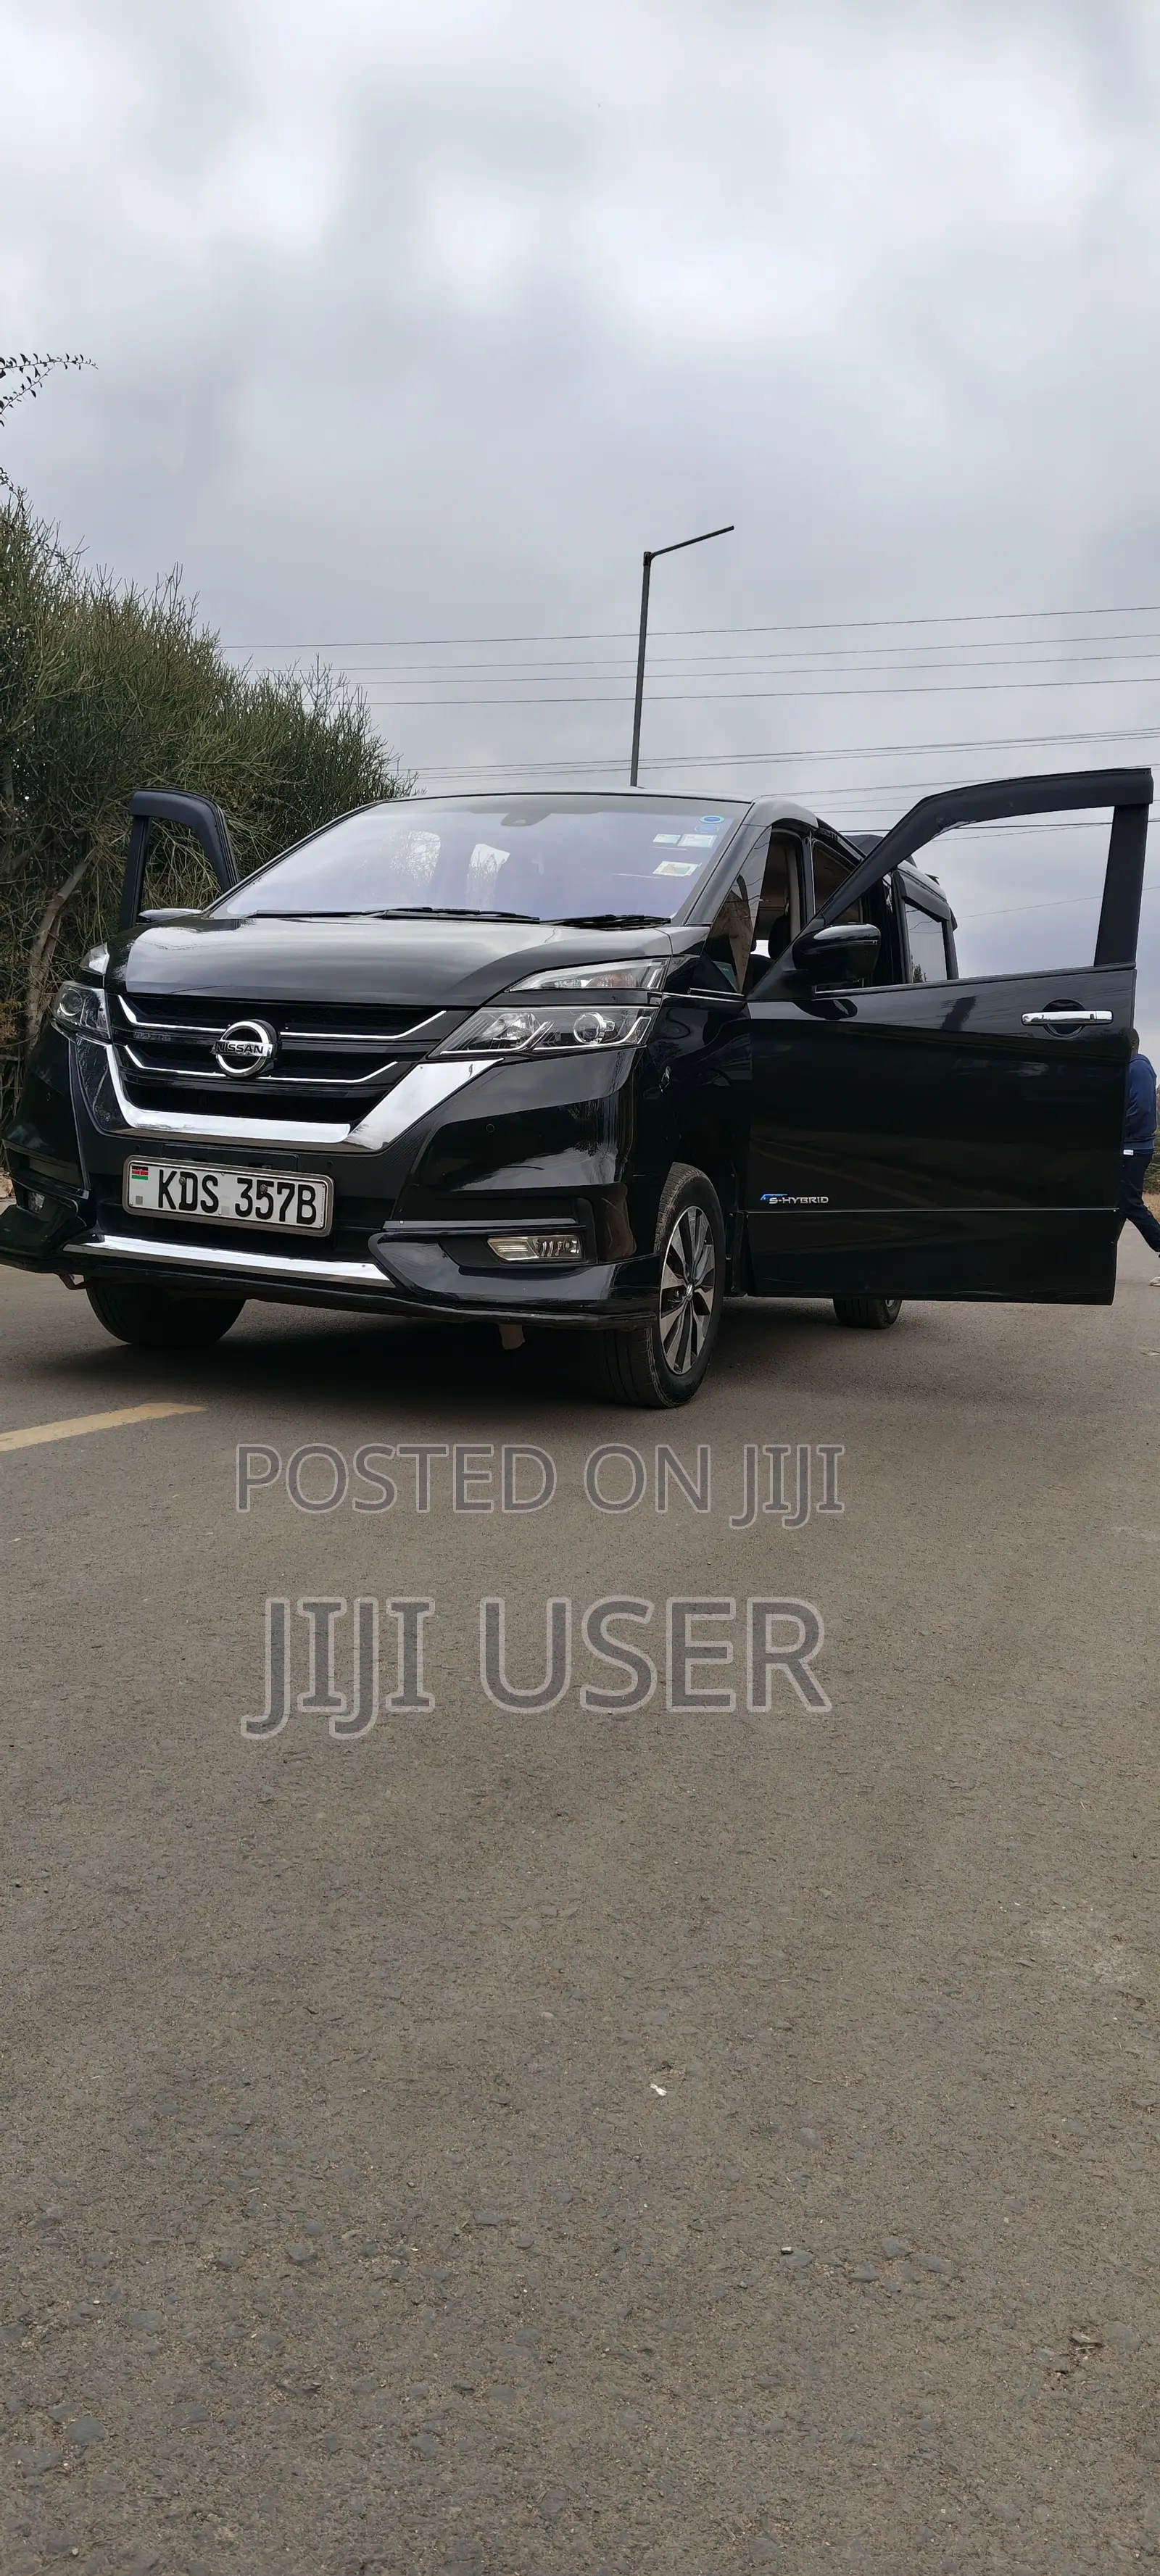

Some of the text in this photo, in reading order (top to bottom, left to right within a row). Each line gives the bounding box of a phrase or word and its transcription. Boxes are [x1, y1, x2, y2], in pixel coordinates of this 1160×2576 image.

[216, 1041, 264, 1055] NISSAN
[158, 1169, 219, 1213] KDS
[235, 1178, 317, 1225] 357B
